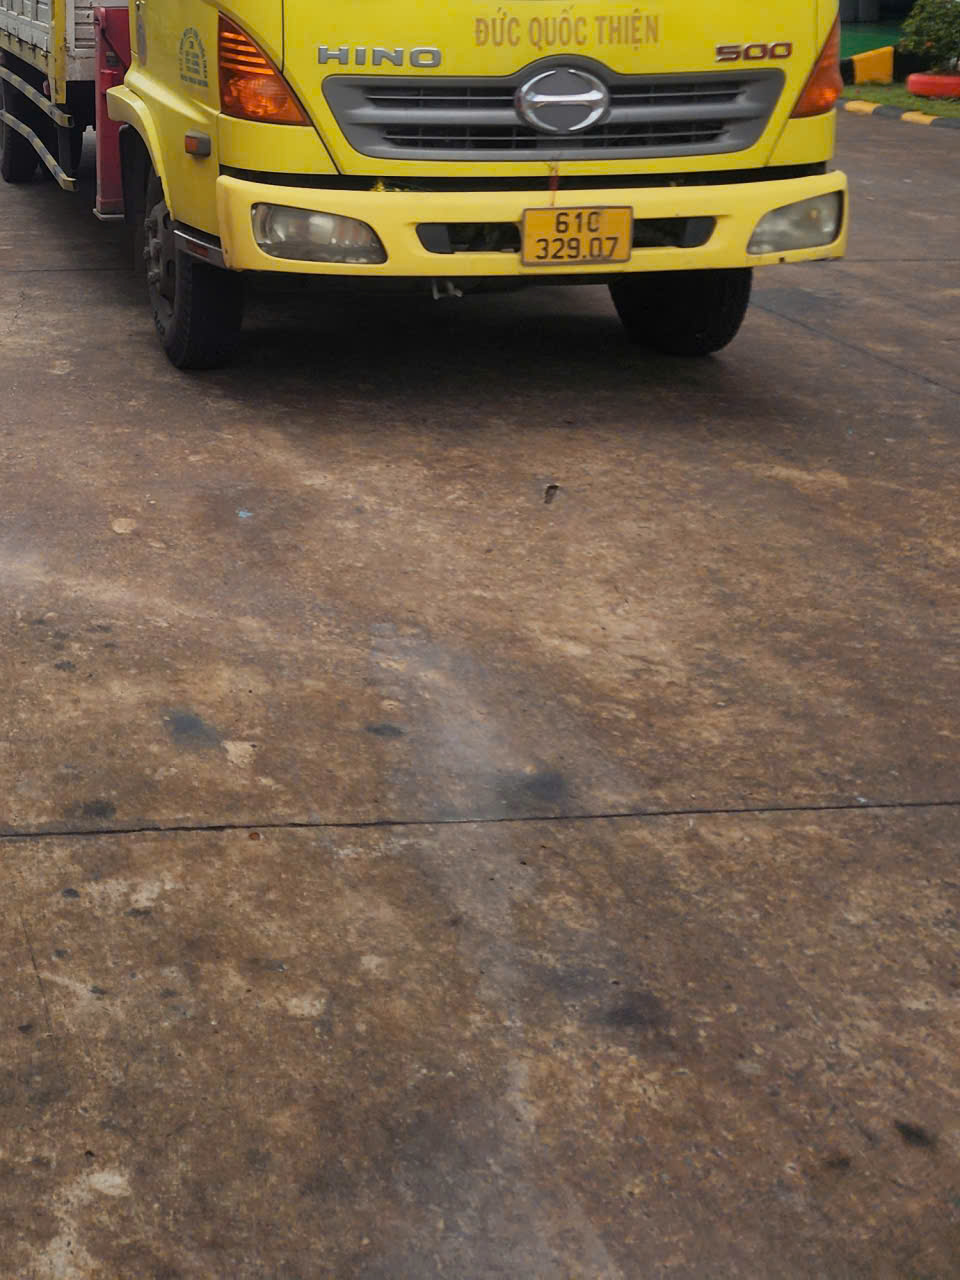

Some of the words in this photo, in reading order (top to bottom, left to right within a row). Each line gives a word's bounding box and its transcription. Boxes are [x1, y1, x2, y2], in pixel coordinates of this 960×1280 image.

[474, 7, 521, 47] ĐỨC
[528, 5, 587, 51] QUỐC
[595, 8, 660, 51] THIỆN
[318, 45, 442, 68] HINO
[715, 42, 792, 62] 500
[555, 211, 600, 234] 61C
[535, 237, 619, 259] 329.07
